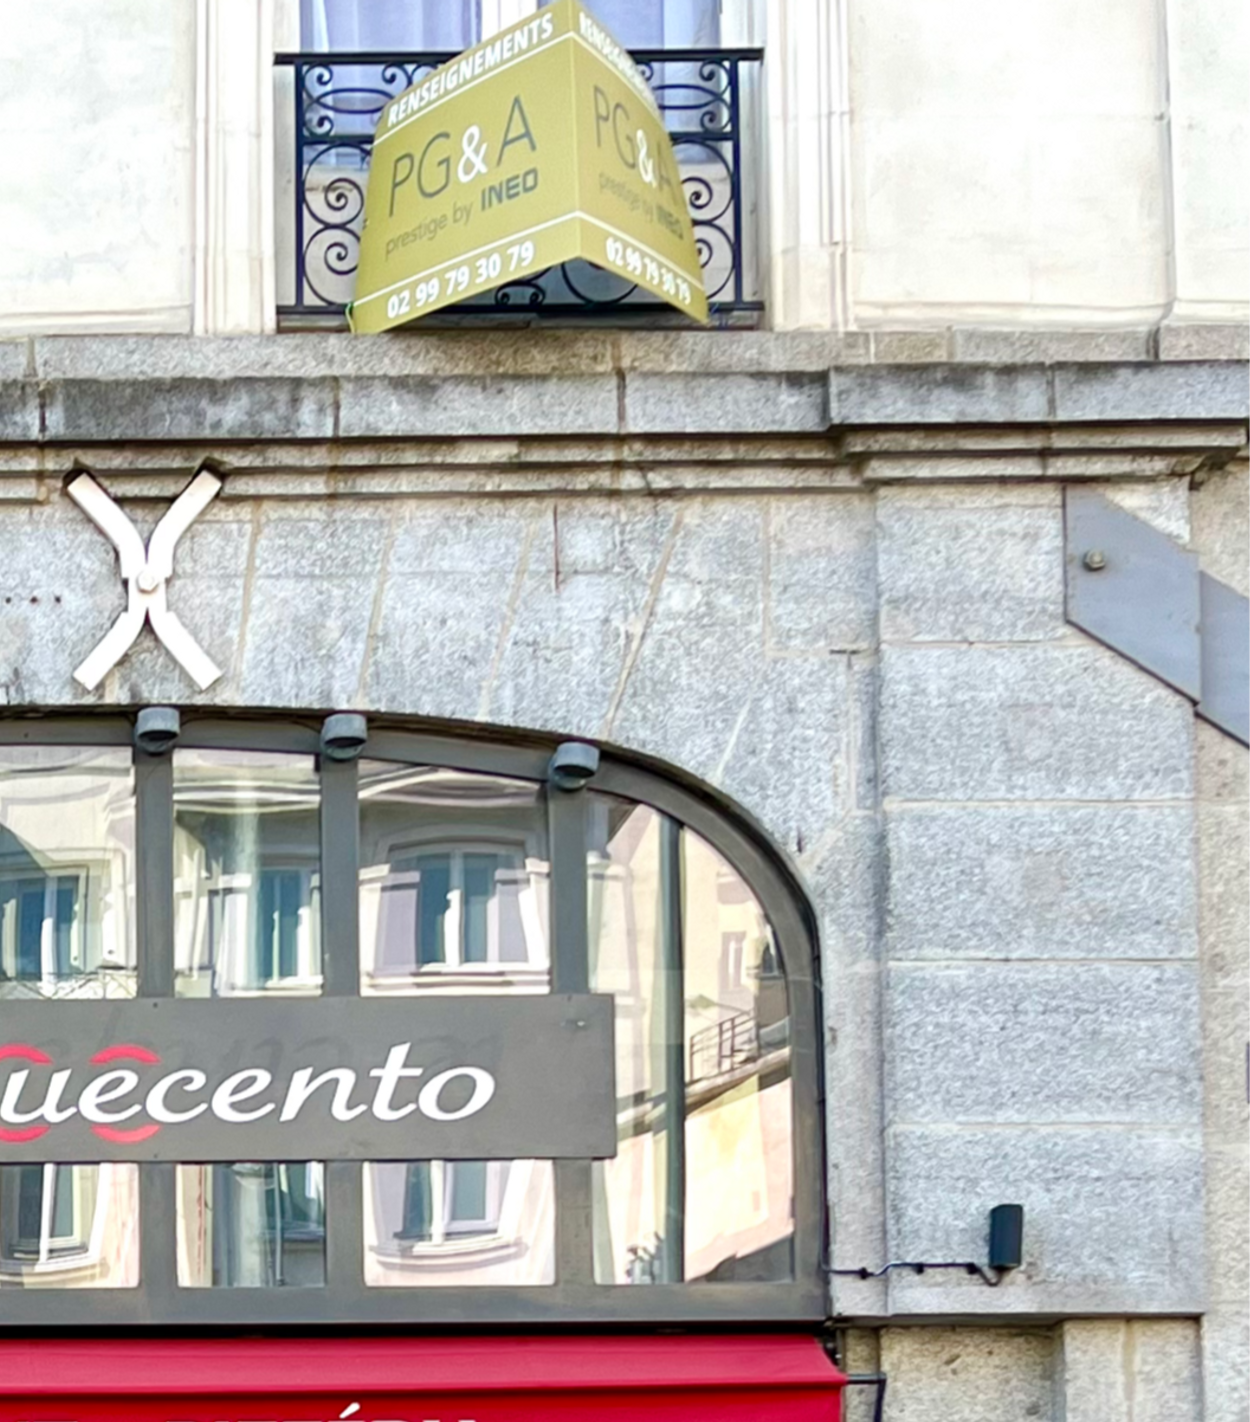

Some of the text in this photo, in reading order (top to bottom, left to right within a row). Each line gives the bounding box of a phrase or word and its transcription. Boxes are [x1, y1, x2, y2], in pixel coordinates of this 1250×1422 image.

[387, 12, 554, 128] RENSEIGNEMENTS
[384, 167, 539, 262] prestige by INEO
[606, 236, 624, 267] 02
[387, 240, 535, 319] 02 99 79 30 79
